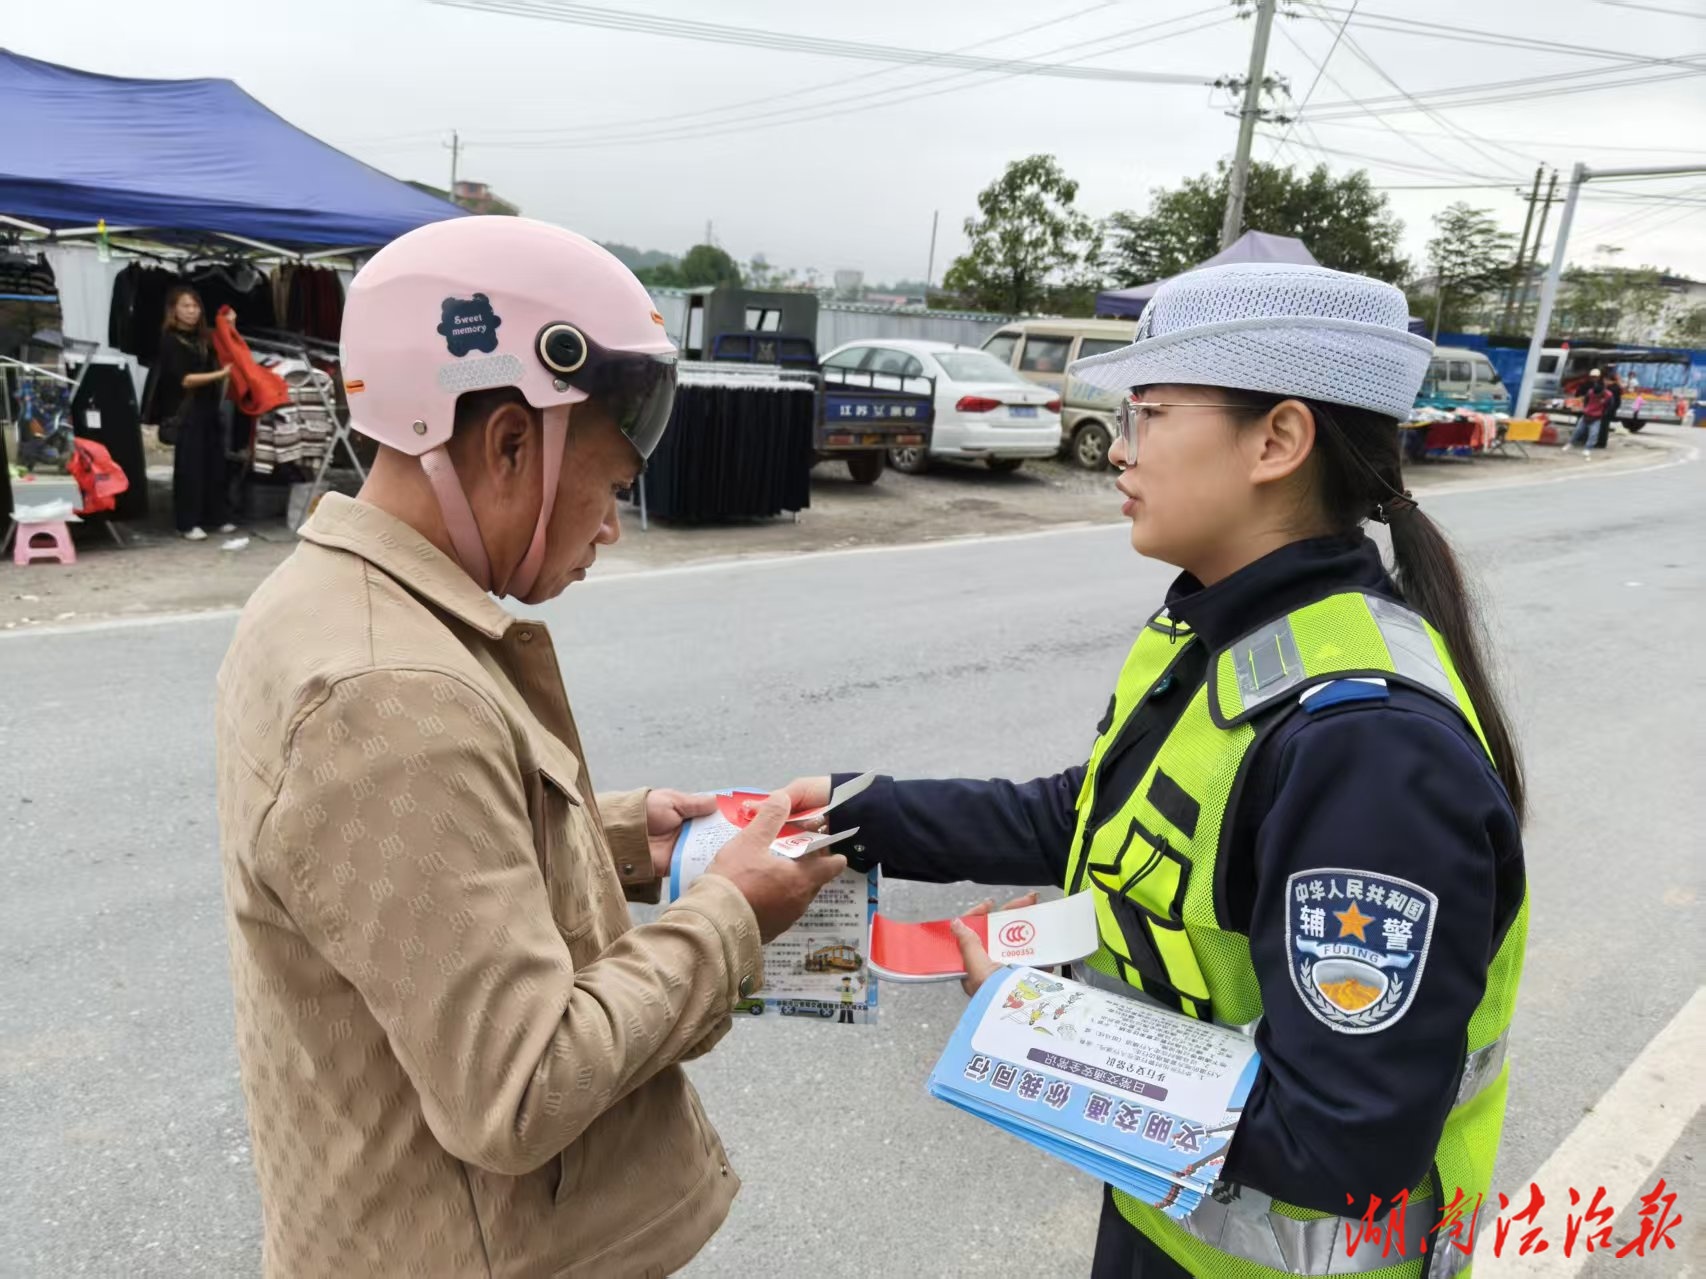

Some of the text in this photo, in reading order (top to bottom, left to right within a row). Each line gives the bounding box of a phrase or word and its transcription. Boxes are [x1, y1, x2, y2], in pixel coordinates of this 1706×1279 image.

[452, 324, 487, 336] memory
[454, 314, 483, 325] Sweet
[840, 404, 868, 417] 江苏
[1295, 878, 1426, 922] 中华人民共和国
[1324, 944, 1379, 963] FUJING
[1044, 1053, 1145, 1093] 日常交通安全常识
[1106, 1056, 1165, 1082] 步行安全常识
[964, 1055, 1206, 1153] 文明交通 你我同行
